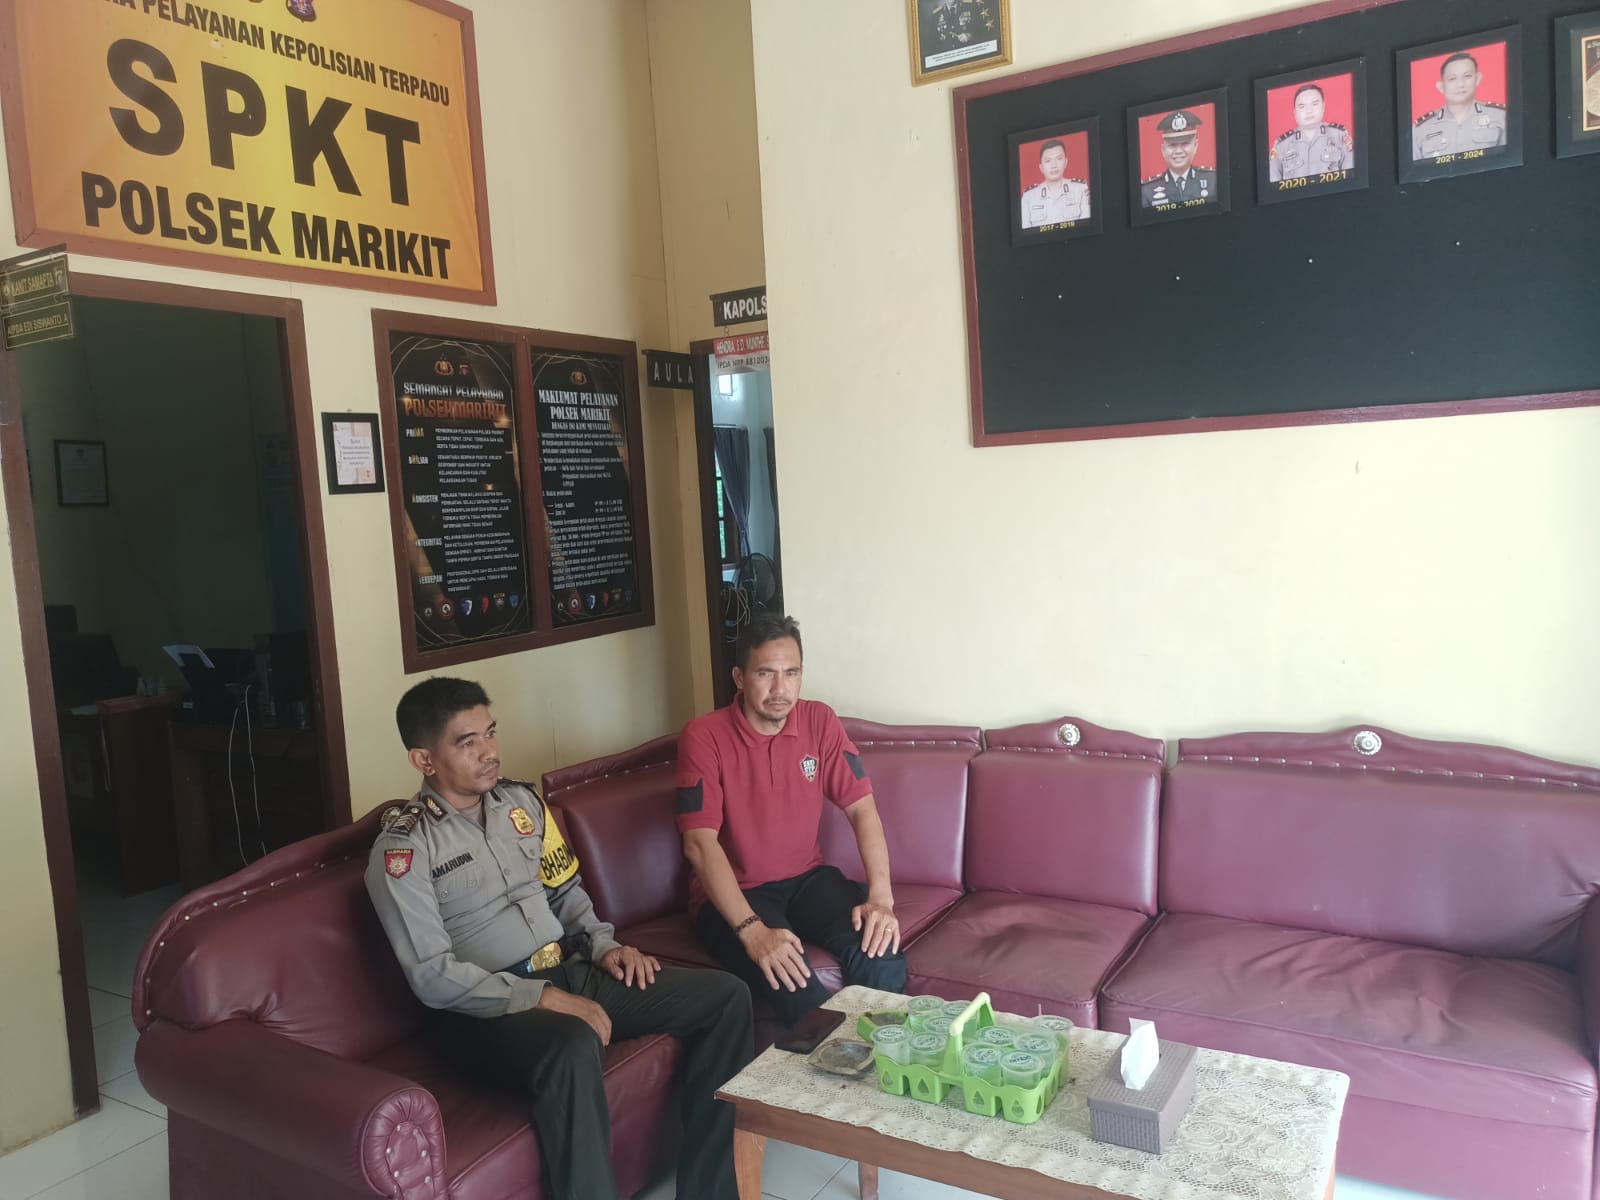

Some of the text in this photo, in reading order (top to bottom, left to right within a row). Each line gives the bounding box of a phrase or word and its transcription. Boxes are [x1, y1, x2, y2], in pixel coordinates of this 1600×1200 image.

[143, 0, 450, 106] PELAYANAN KEPOLISIAN TERPADU
[106, 38, 421, 206] SPKT
[1436, 154, 1453, 165] 2021
[1464, 149, 1485, 160] 2024
[1279, 177, 1307, 191] 2020
[1319, 170, 1347, 184] 2021
[81, 171, 451, 280] POLSEK MARIKIT
[654, 361, 694, 384] AULA
[403, 382, 504, 400] SEMANGAT PELAYANAN
[538, 389, 619, 407] MAKLUMAT PELAYANAN
[550, 406, 610, 421] POLSEK MARIKIT
[432, 851, 474, 880] AMARUDIN
